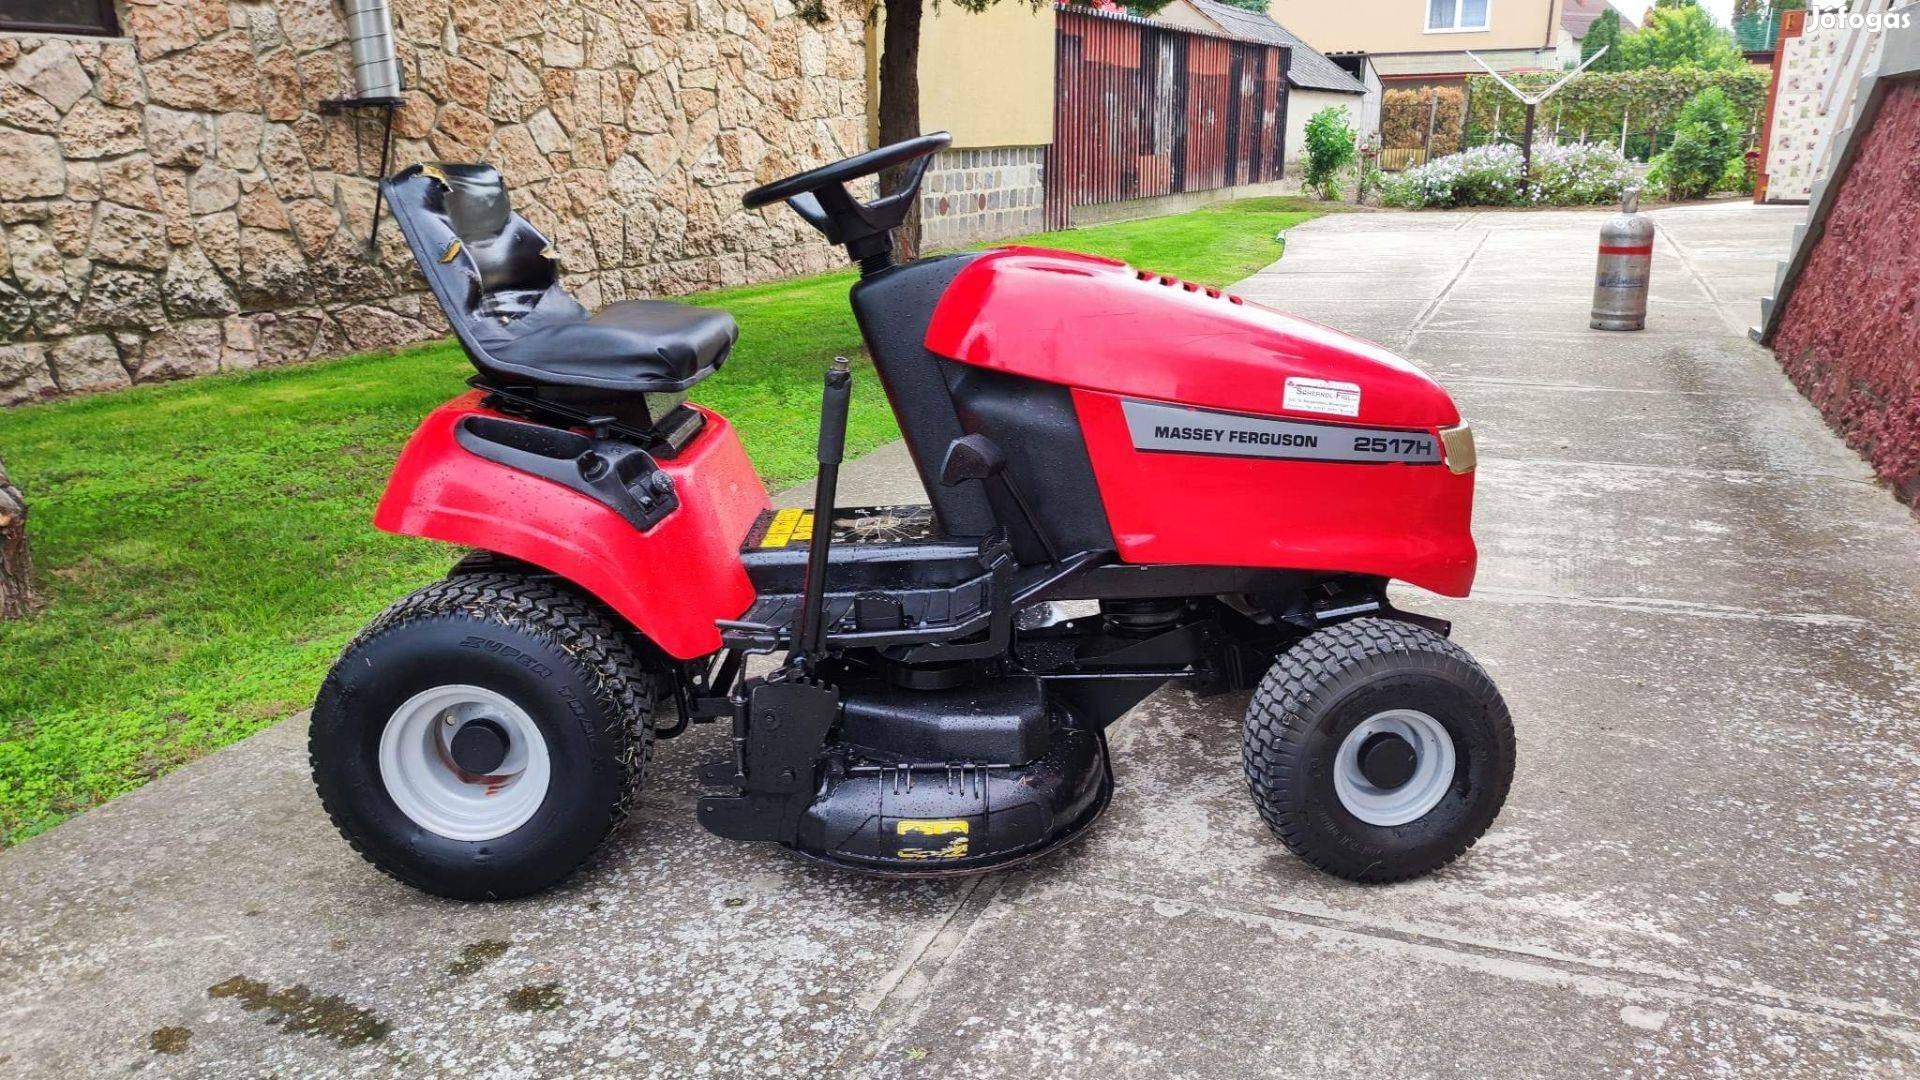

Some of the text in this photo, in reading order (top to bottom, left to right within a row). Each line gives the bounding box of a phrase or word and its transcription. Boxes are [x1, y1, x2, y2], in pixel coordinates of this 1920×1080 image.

[1154, 425, 1432, 456] MASSEY FERGUSON 2517H
